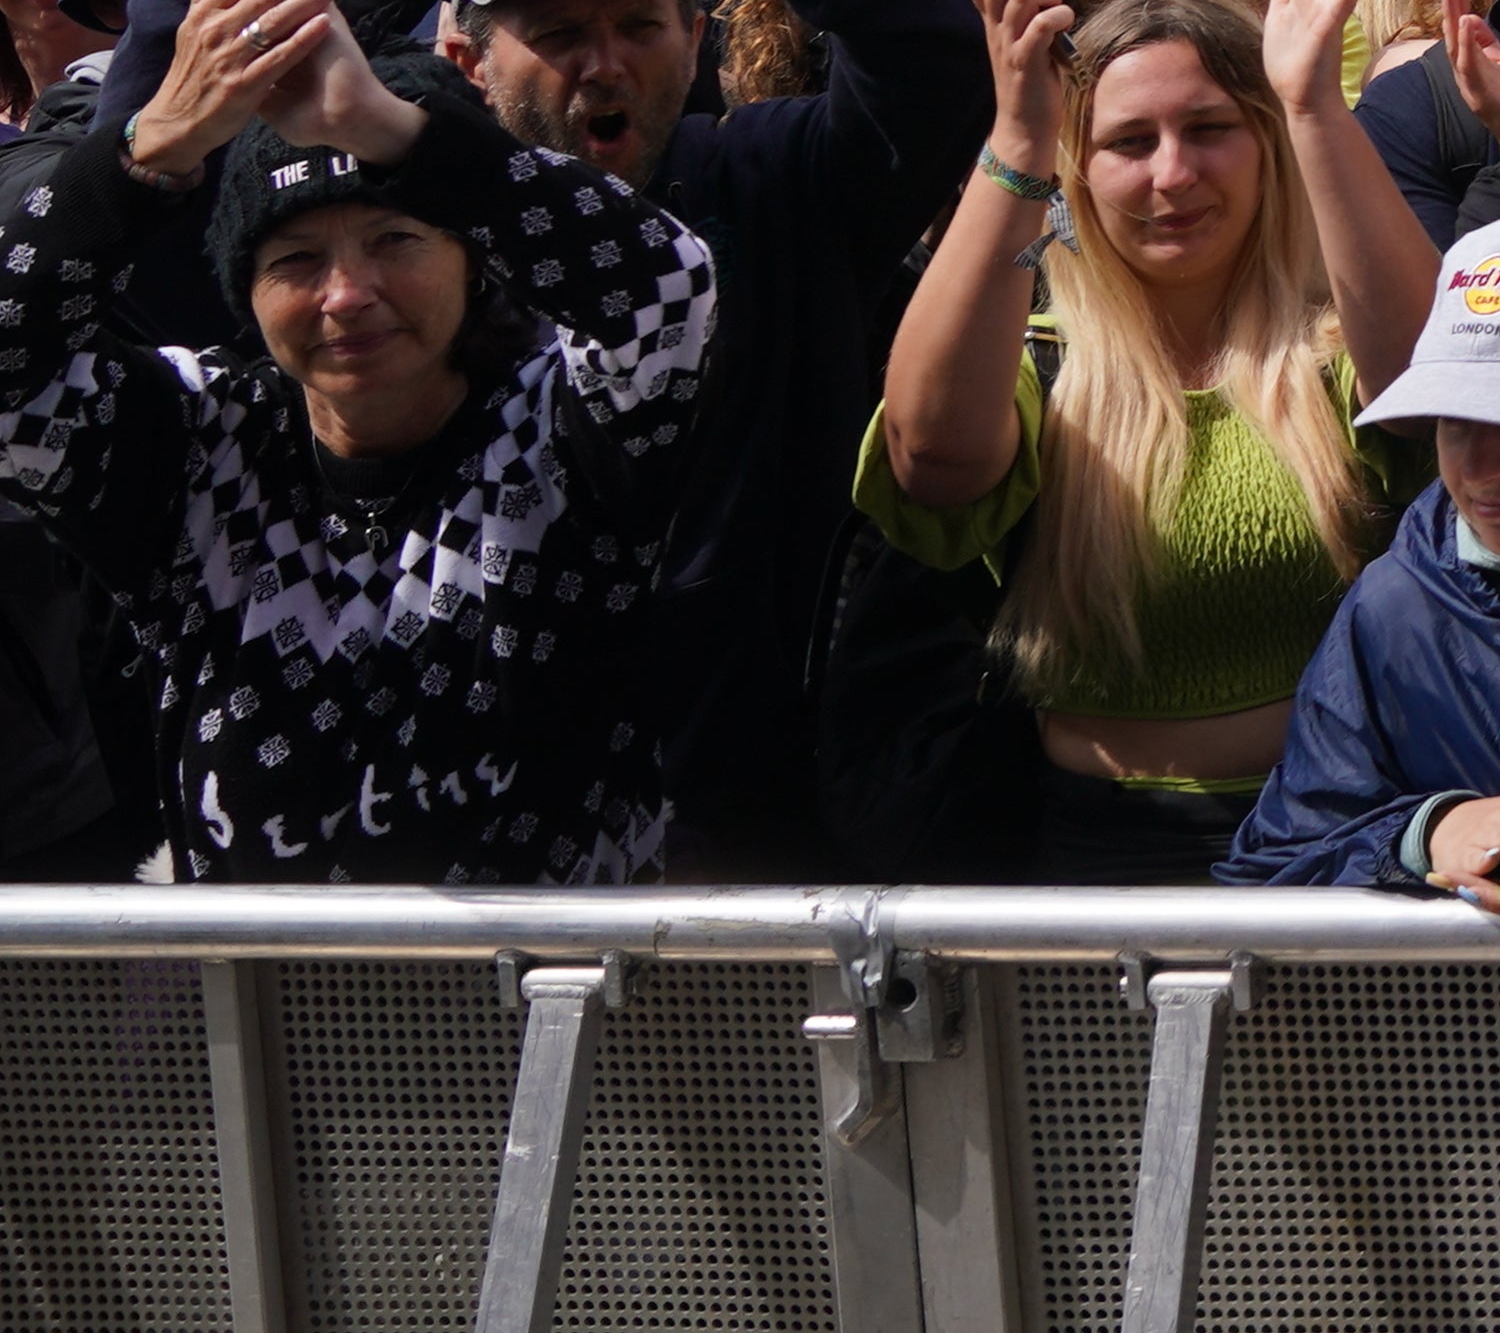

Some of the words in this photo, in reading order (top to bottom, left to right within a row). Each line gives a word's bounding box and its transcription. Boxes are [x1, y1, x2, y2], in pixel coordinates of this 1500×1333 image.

[271, 159, 310, 190] THE
[1447, 268, 1495, 292] Hard
[1474, 294, 1500, 307] CAFE
